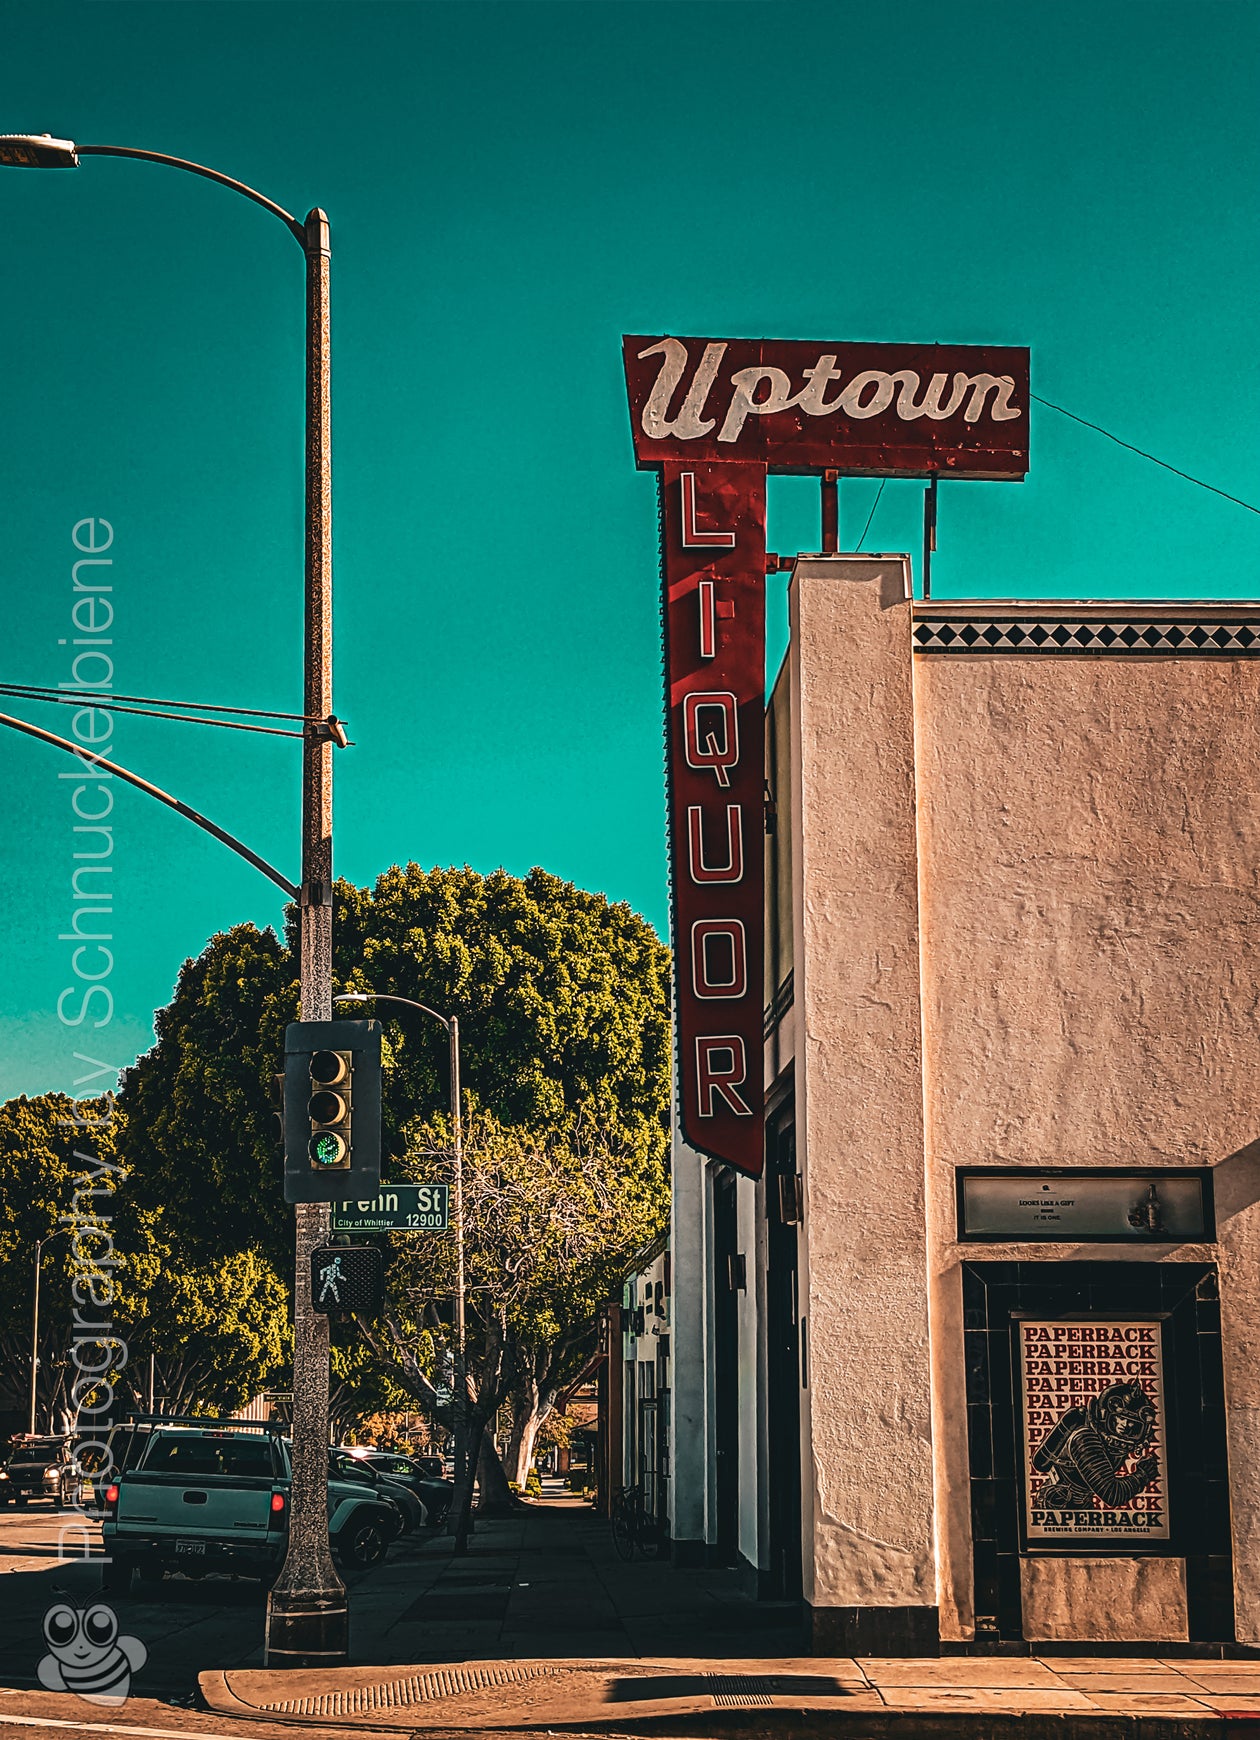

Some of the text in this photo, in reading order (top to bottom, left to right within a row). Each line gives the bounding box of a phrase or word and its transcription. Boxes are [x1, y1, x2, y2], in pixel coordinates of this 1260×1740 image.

[637, 338, 1022, 443] Uptown
[680, 472, 754, 1118] LIQUOR
[417, 1187, 441, 1212] St
[337, 1219, 394, 1228] City of Whittier
[406, 1213, 443, 1227] 12900
[1024, 1327, 1158, 1342] PAPERBACK
[1025, 1344, 1159, 1359] PAPERBACK
[1026, 1361, 1160, 1376] PAPERBACK
[1031, 1511, 1165, 1527] PAPERBACK
